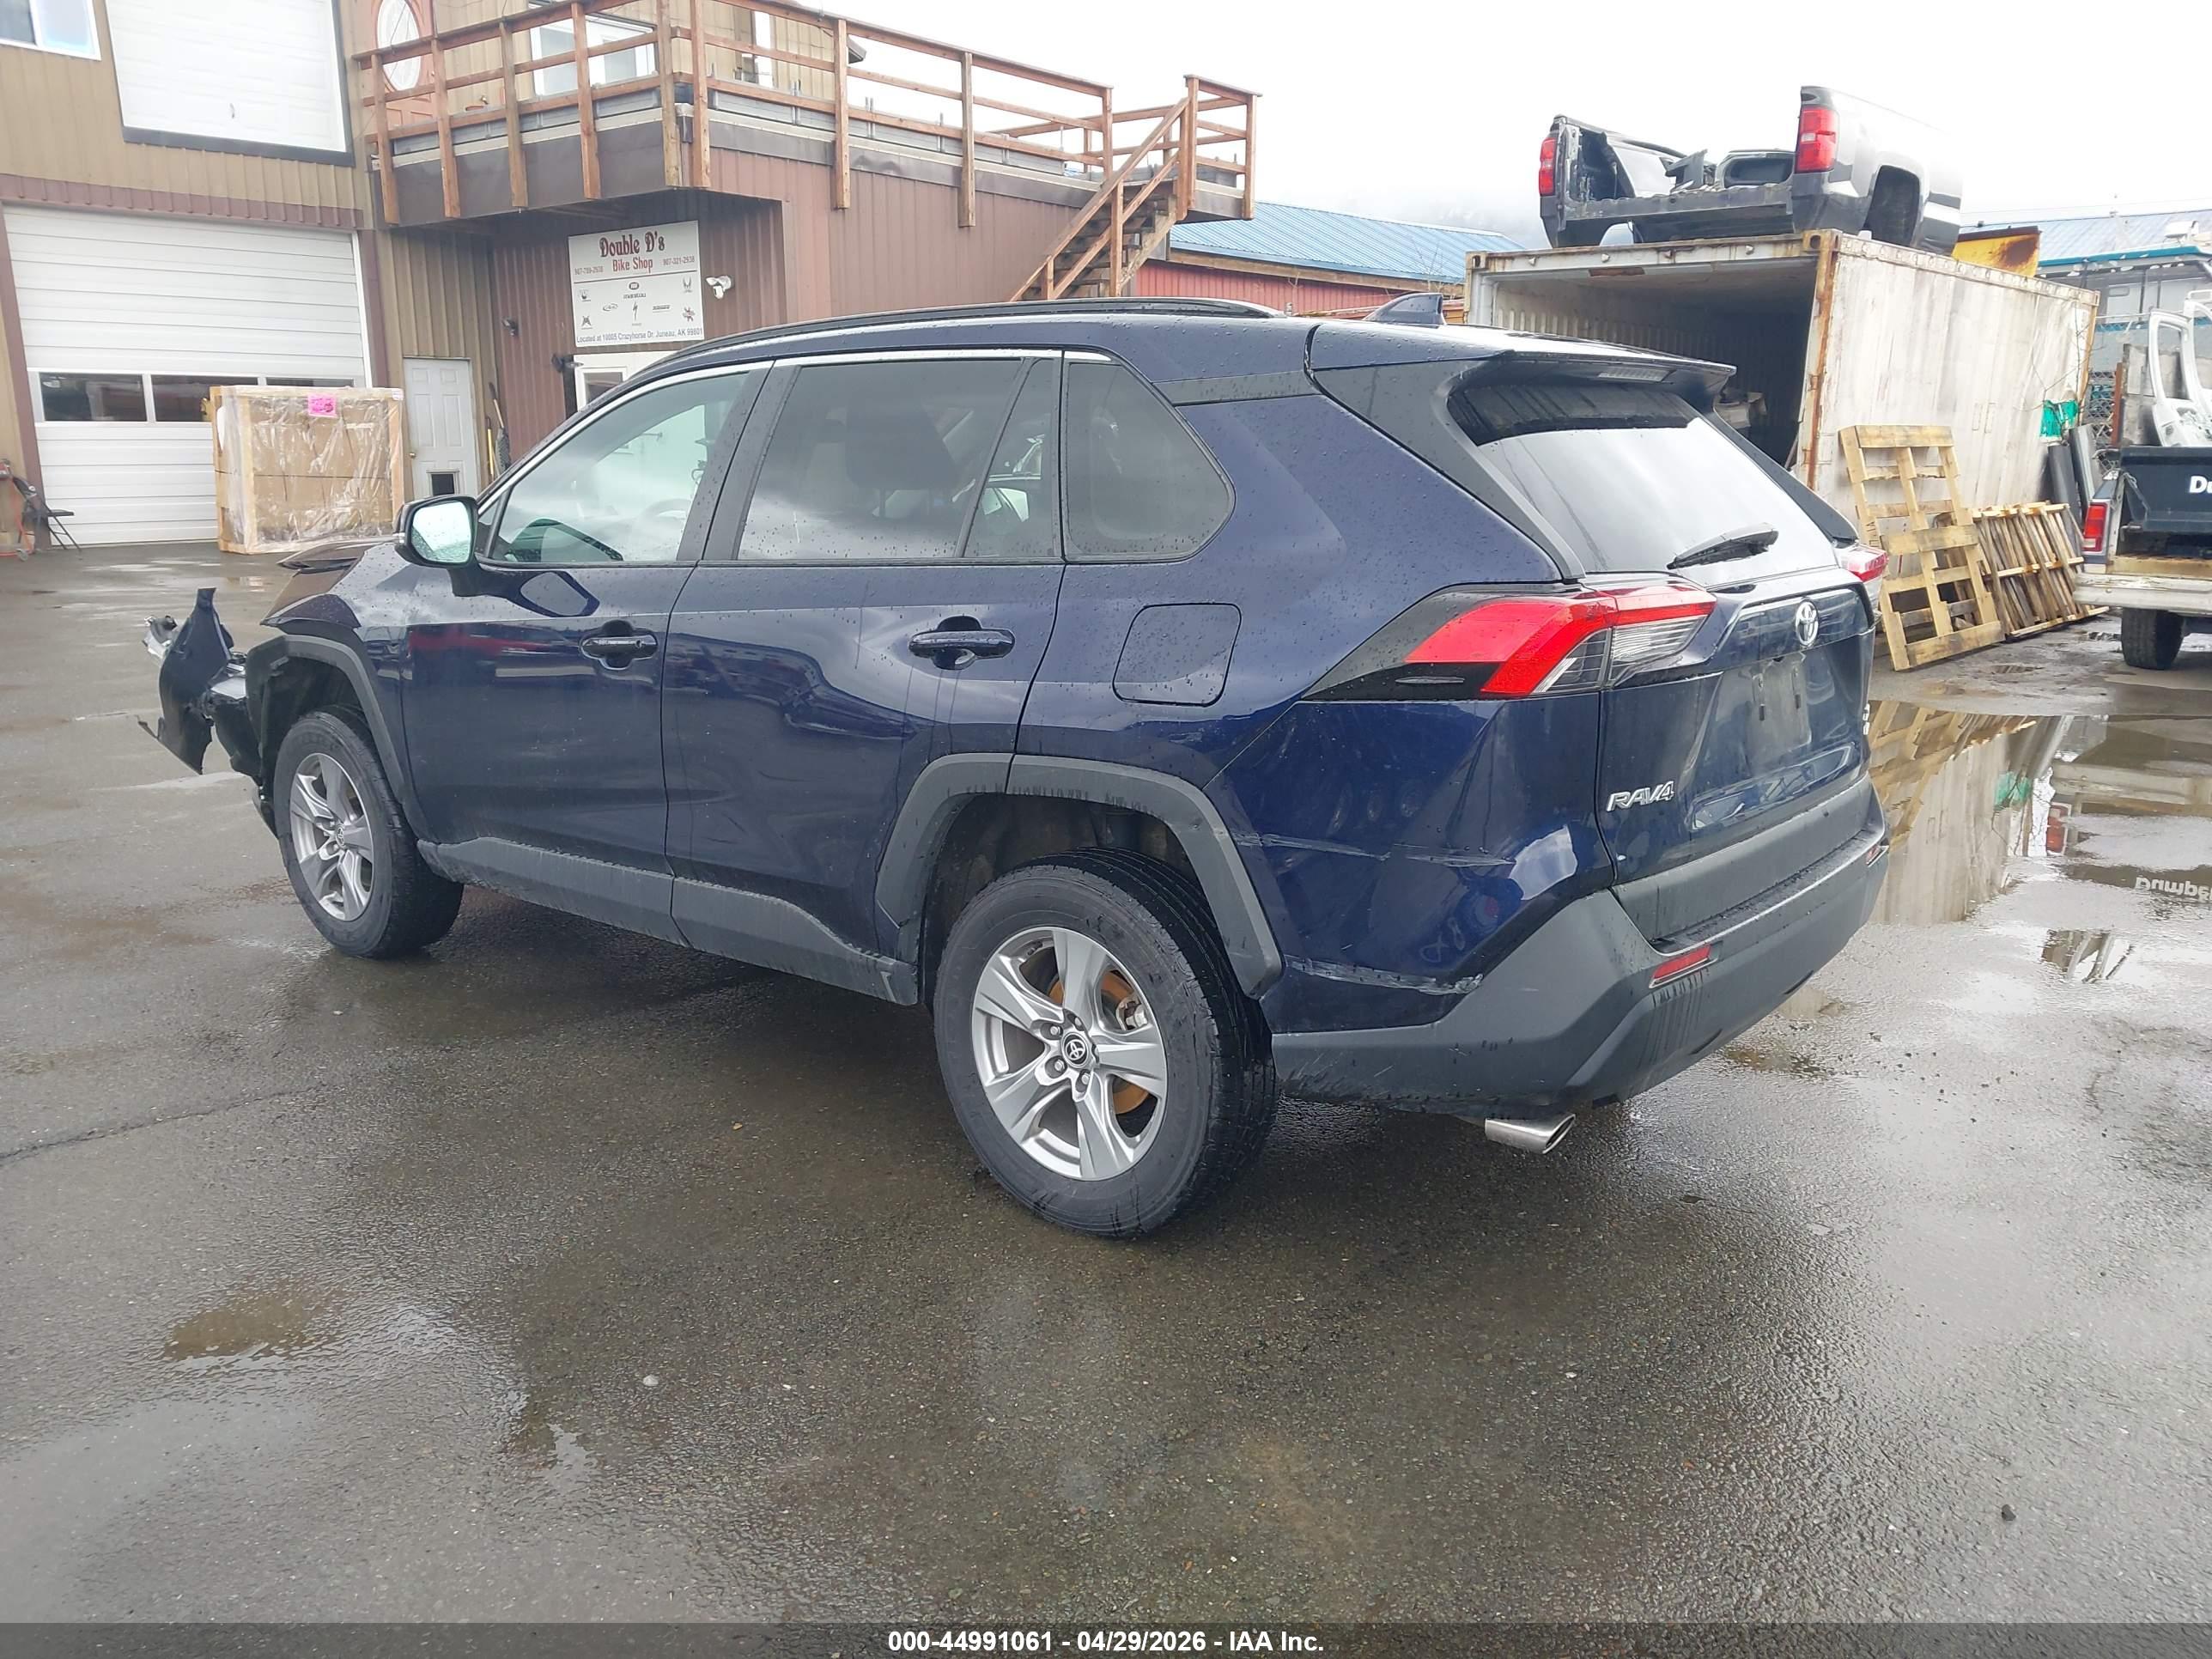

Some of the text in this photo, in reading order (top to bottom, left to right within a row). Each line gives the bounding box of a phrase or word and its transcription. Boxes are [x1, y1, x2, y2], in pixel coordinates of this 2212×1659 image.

[599, 230, 665, 258] Double D's
[612, 257, 653, 274] Bike Shop
[1606, 780, 1675, 812] RAV4
